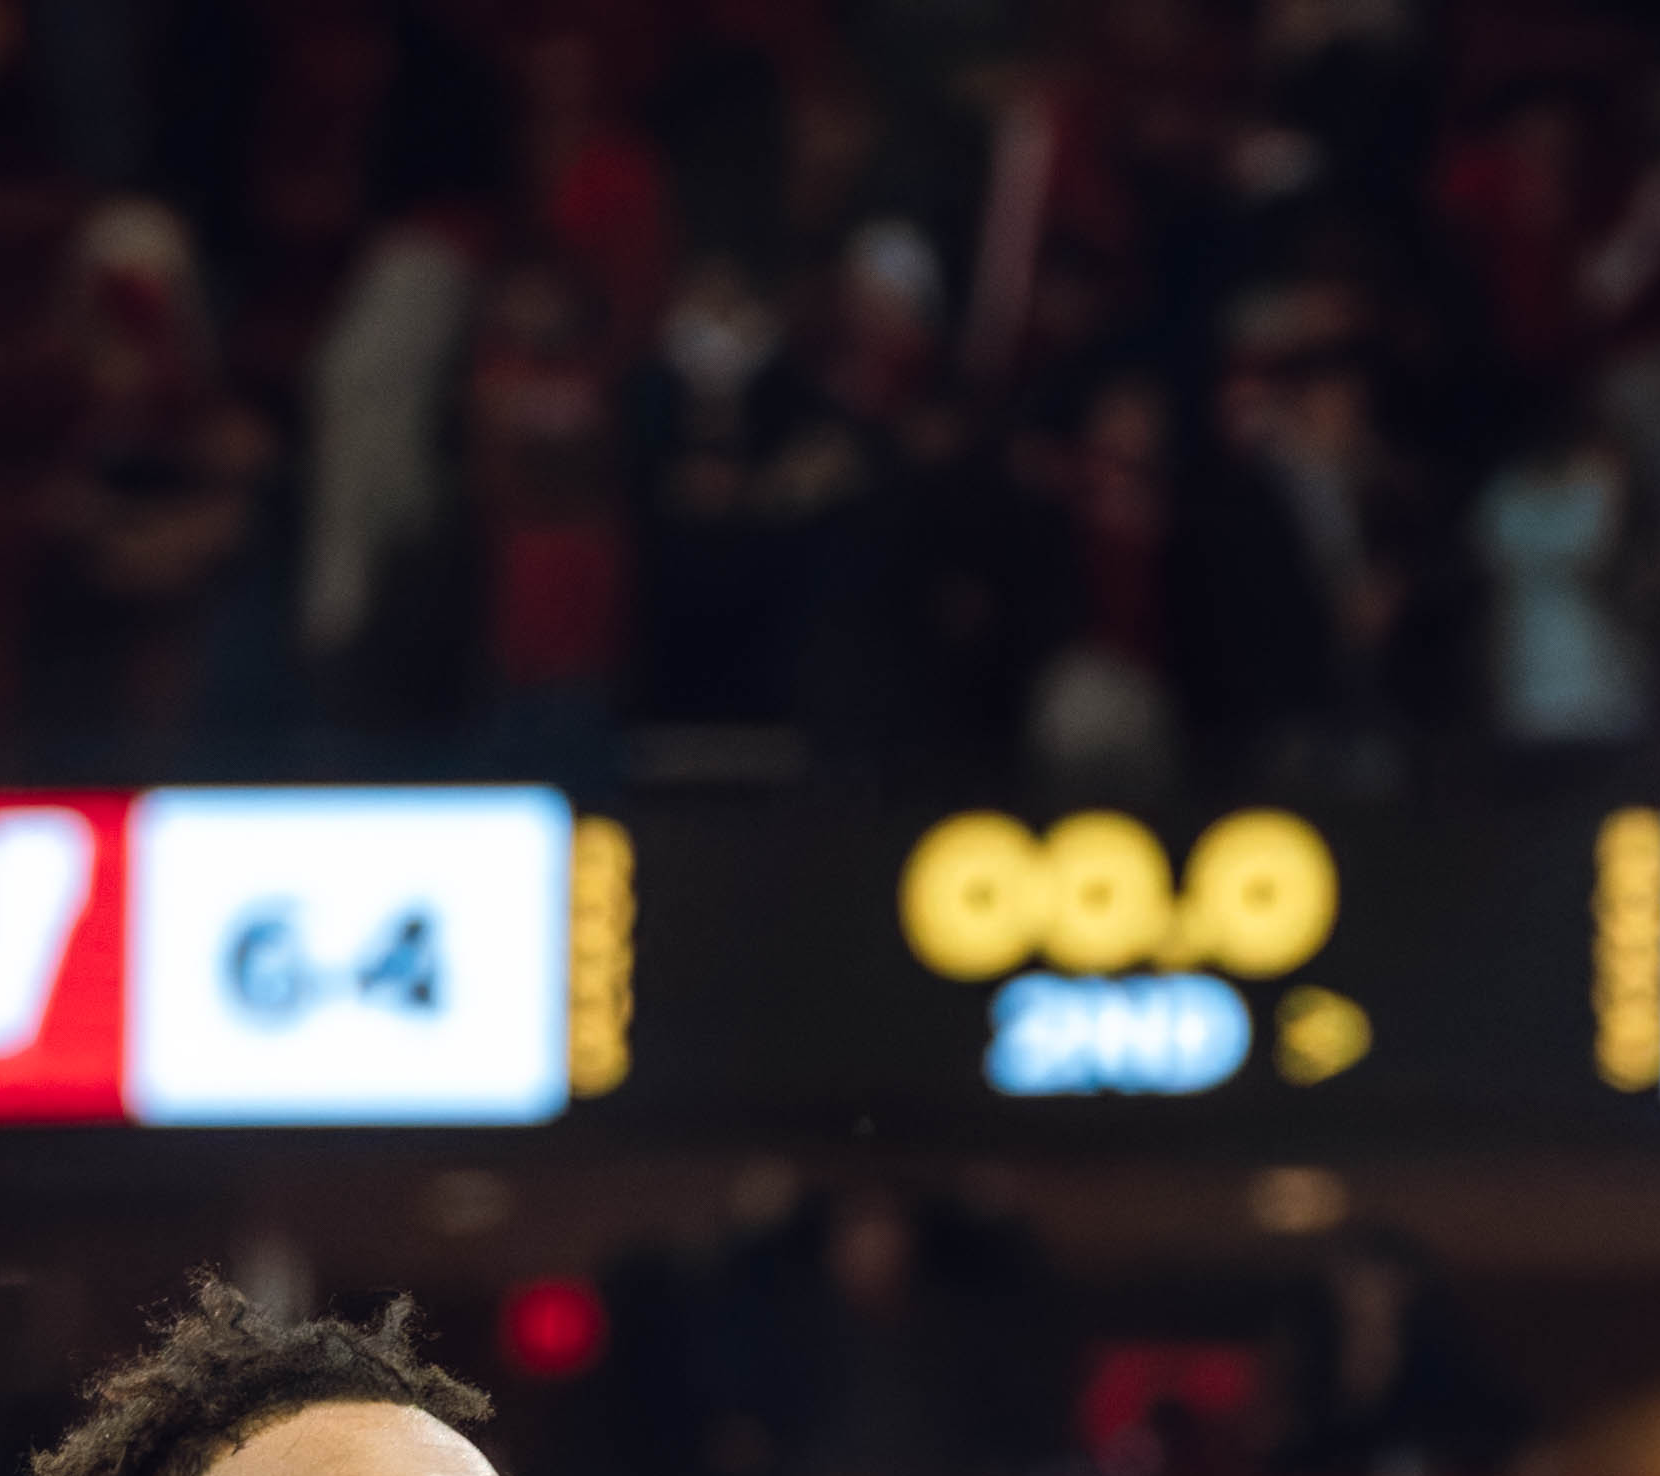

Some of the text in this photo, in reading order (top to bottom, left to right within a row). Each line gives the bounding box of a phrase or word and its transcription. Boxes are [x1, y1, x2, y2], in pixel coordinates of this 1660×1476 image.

[218, 892, 450, 1030] 64
[900, 808, 1340, 980] 00.0
[986, 970, 1254, 1097] 2ND
